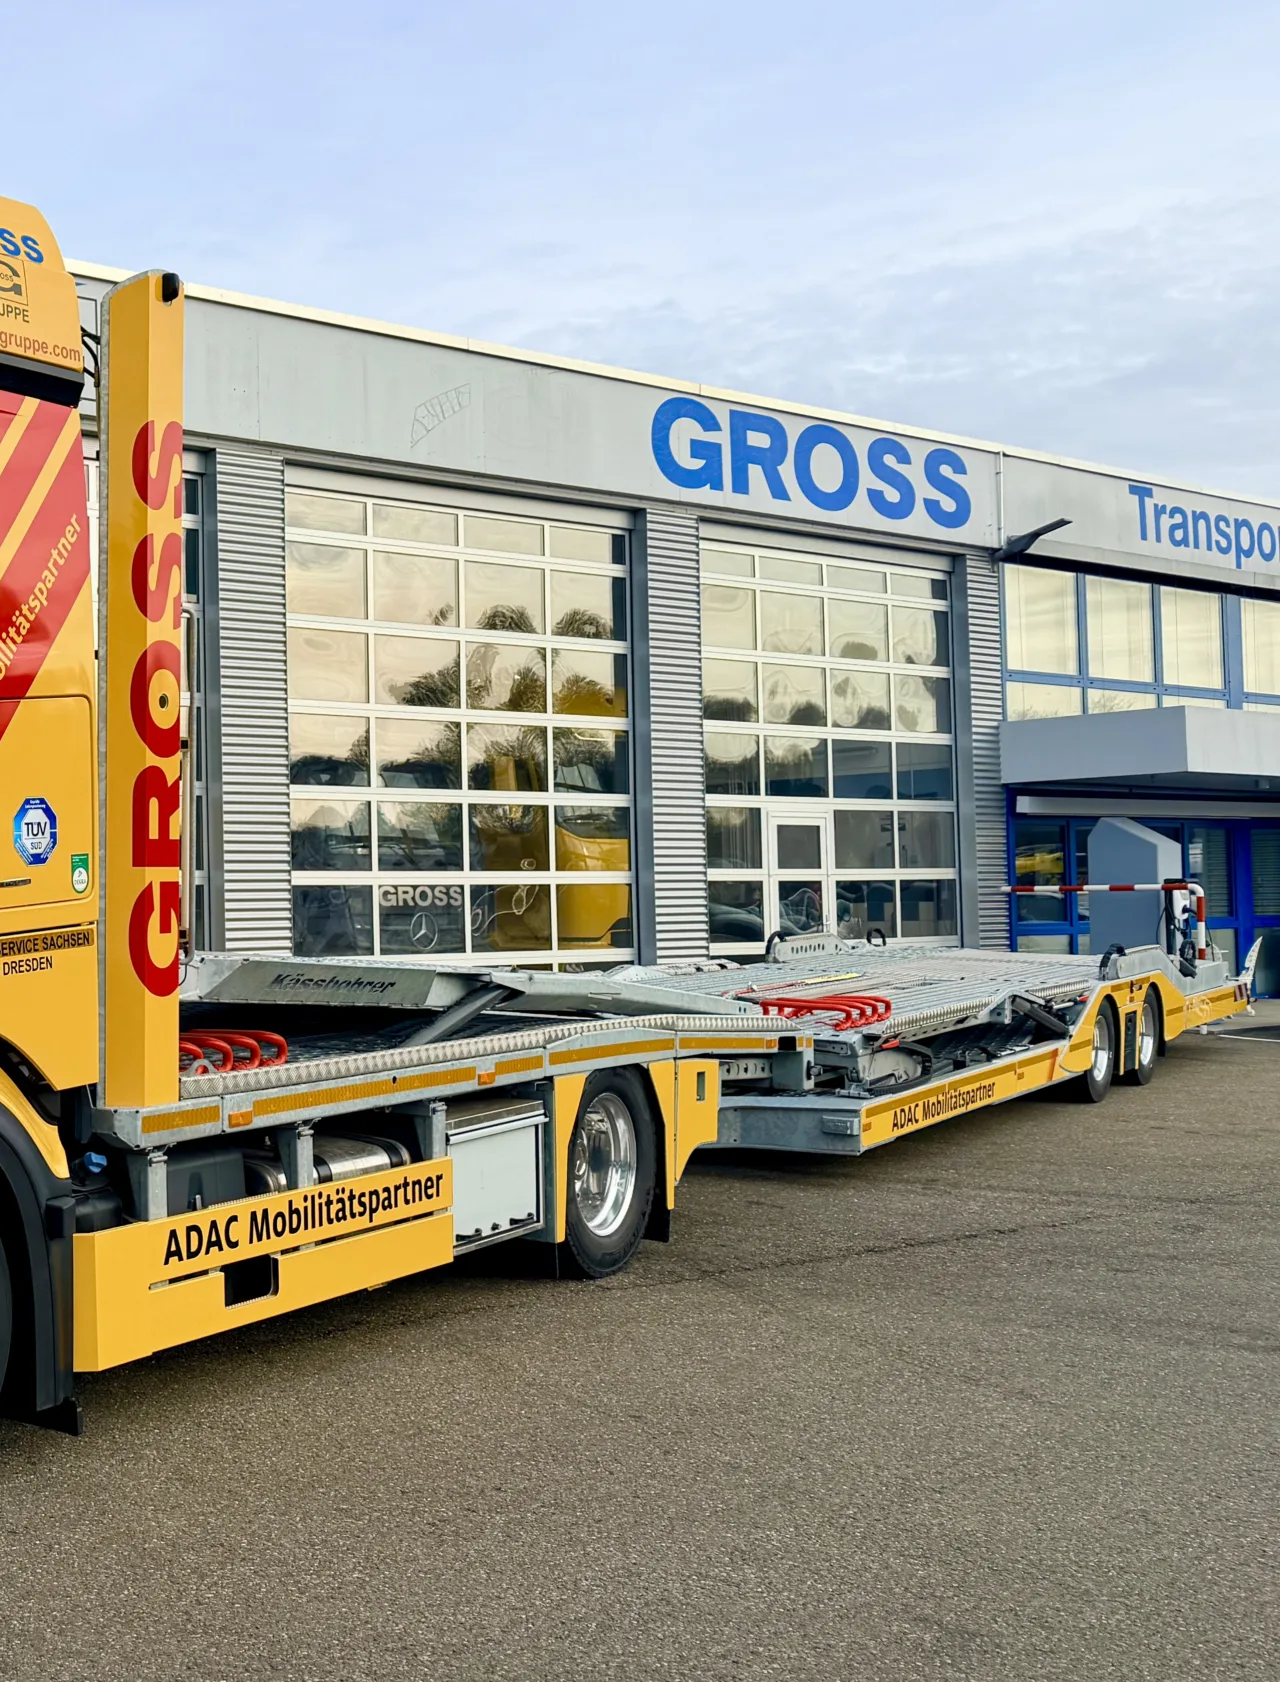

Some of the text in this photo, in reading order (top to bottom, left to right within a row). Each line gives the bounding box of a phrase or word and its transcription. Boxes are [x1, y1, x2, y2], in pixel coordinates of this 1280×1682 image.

[651, 397, 972, 529] GROSS
[128, 420, 182, 998] GROSS
[24, 821, 47, 837] TÜV
[378, 886, 462, 907] GROSS
[41, 931, 90, 951] SACHSEN
[3, 956, 53, 976] DRESDEN
[892, 1081, 996, 1132] ADAC Mobilitätspartner
[163, 1172, 444, 1266] ADAC Mobilitätspartner
